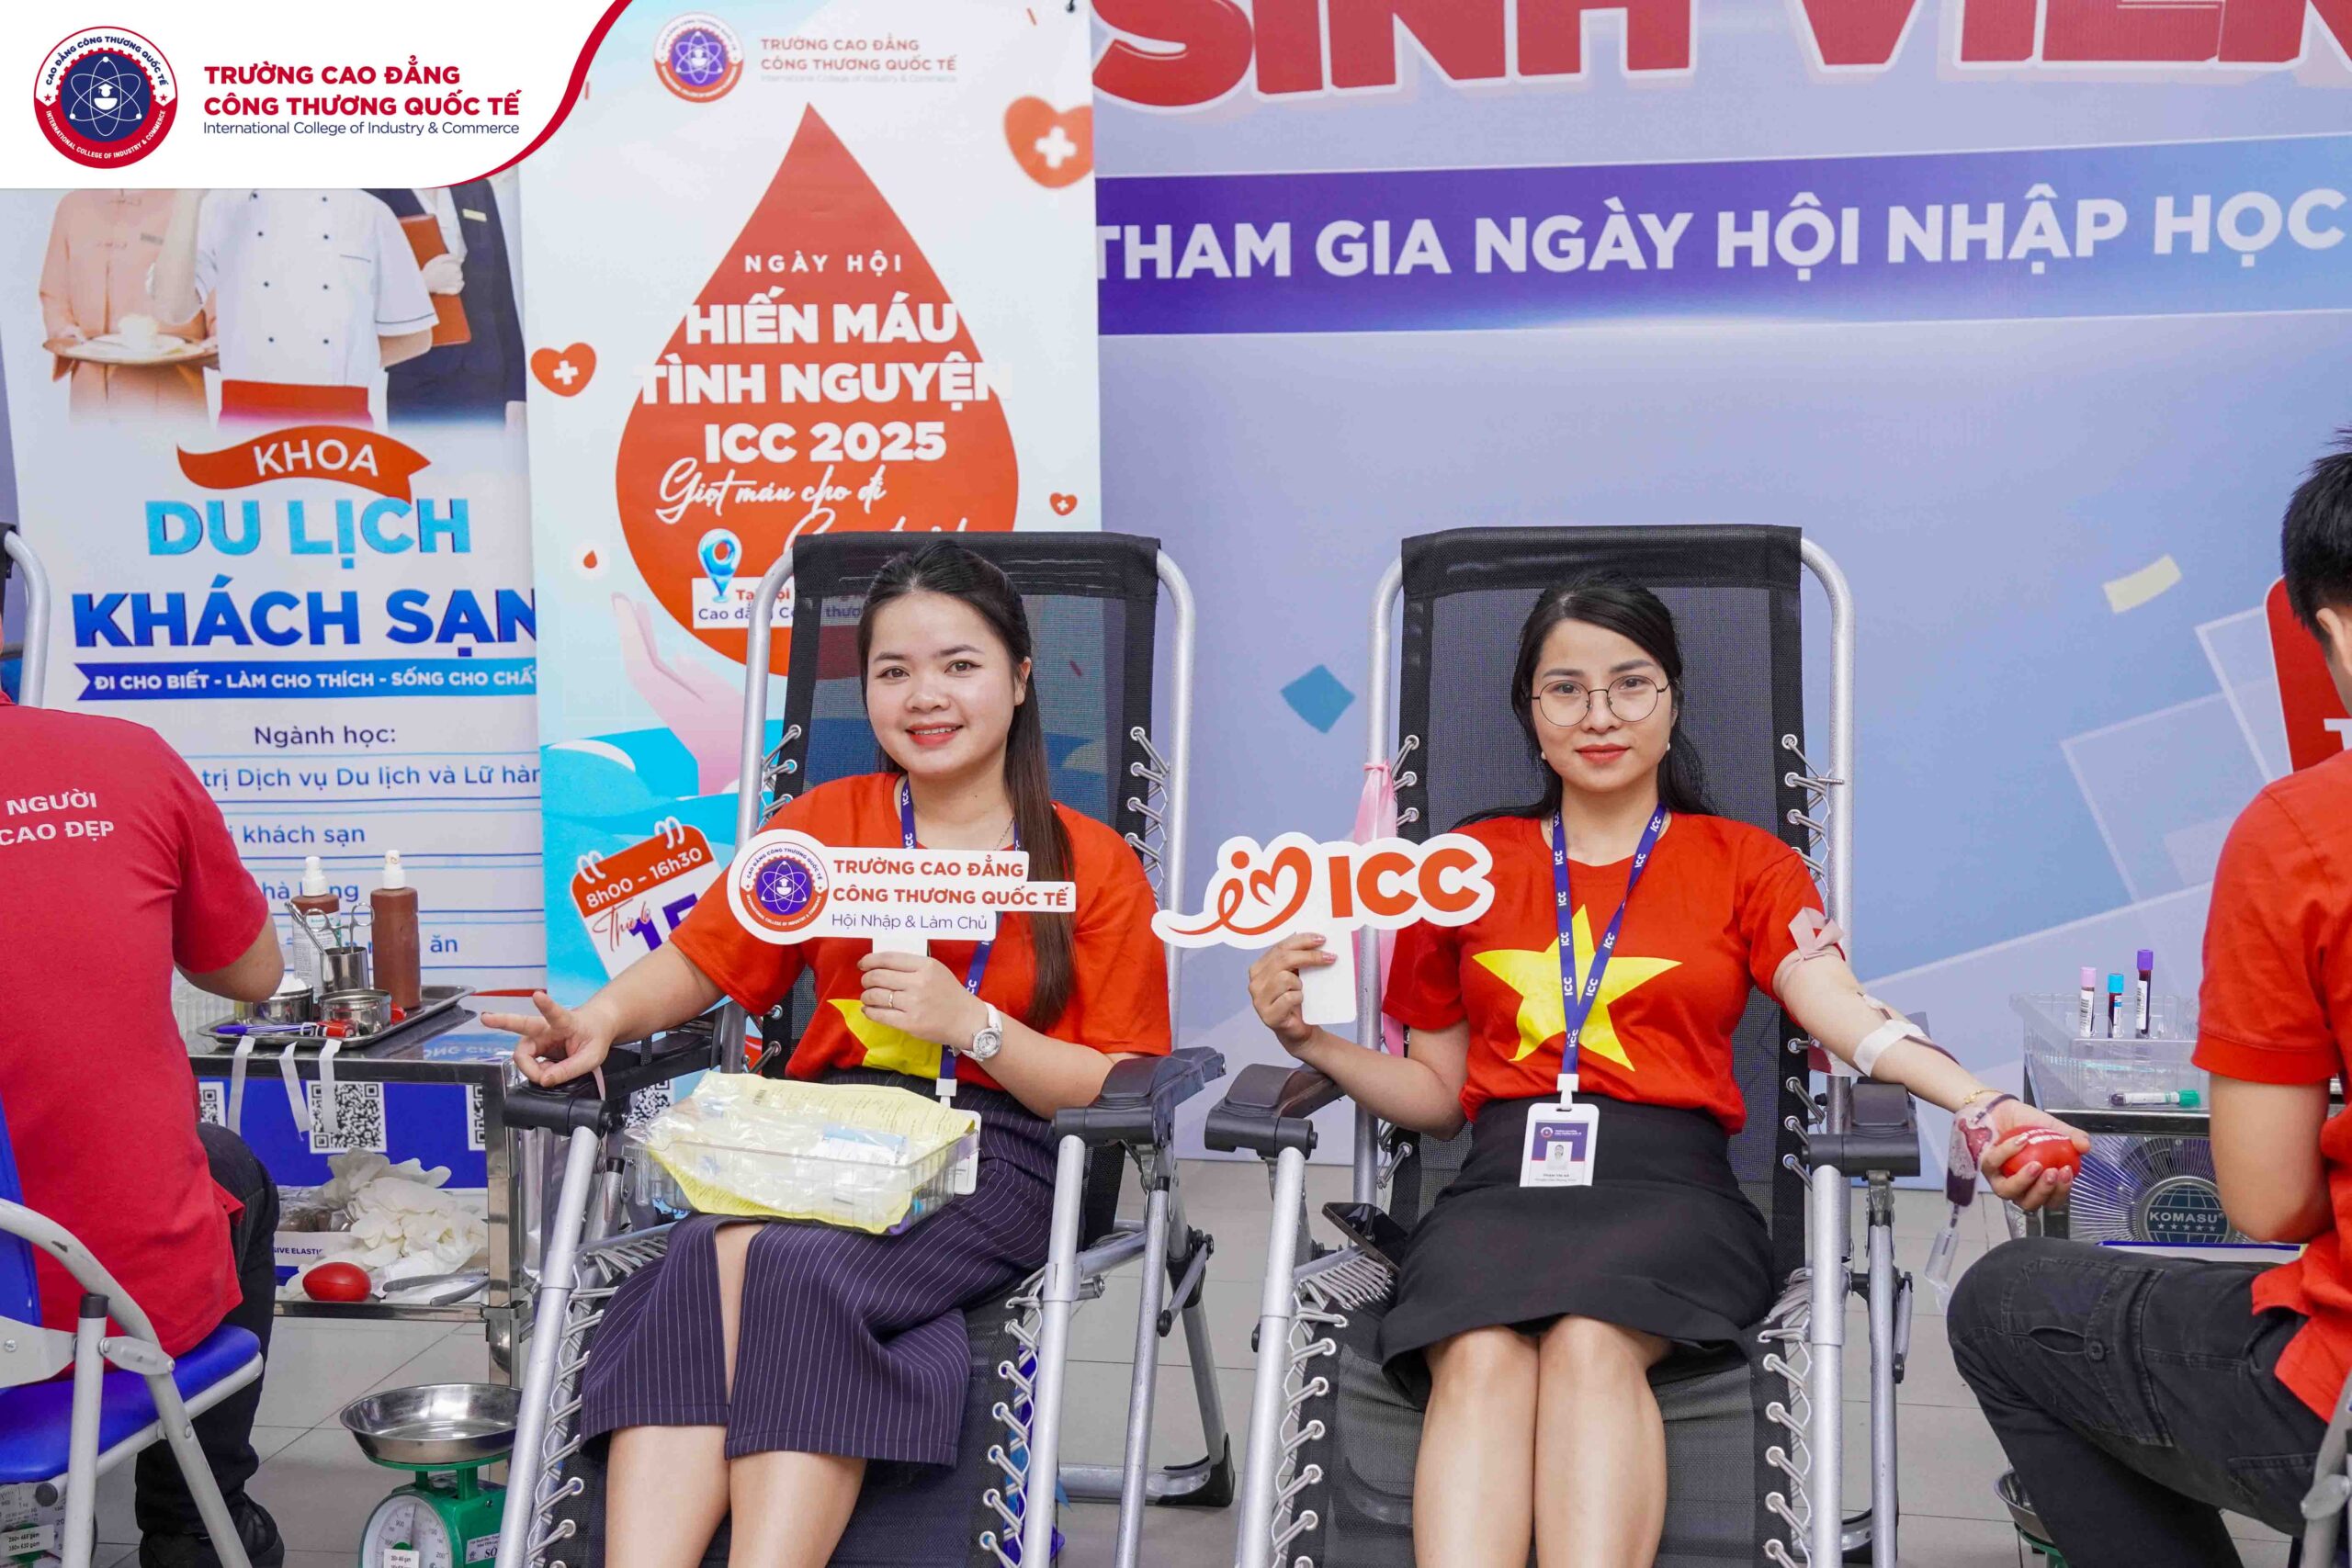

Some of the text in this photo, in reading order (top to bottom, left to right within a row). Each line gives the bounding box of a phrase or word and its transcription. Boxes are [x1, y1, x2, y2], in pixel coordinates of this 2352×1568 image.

[833, 39, 867, 51] CAO
[1096, 184, 2346, 281] THAM GIA NGÀY HỘI NHẬP HỌC
[745, 250, 902, 277] NGÀY HỘI
[684, 286, 958, 344] HIẾN MÁU
[631, 352, 1012, 412] TÌNH NGUYỆN
[705, 421, 947, 464] ICC 2025
[254, 439, 379, 477] KHOA
[735, 479, 796, 502] máu
[801, 465, 852, 513] cho
[144, 497, 471, 570] DU LỊCH
[736, 589, 755, 603] Ta
[71, 574, 537, 657] KHÁCH SẠN
[698, 608, 729, 621] Cao
[96, 675, 115, 691] ĐI
[120, 675, 163, 690] CHO
[167, 669, 209, 690] BIẾT
[227, 671, 267, 689] LÀM
[272, 673, 312, 689] CHO
[317, 670, 375, 688] THÍCH
[391, 667, 444, 687] SỐNG
[449, 671, 488, 686] CHO
[254, 726, 395, 748] Ngành học:
[202, 770, 229, 791] trị
[238, 768, 290, 791] Dịch
[300, 772, 327, 791] vụ
[337, 768, 368, 786] Du
[379, 765, 419, 789] lịch
[429, 768, 456, 784] và
[465, 765, 493, 784] Lữ
[6, 788, 97, 816] NGƯỜI
[0, 820, 114, 845] CAO ĐẸP
[1650, 816, 1661, 832] ICC
[243, 825, 314, 843] khách
[324, 827, 366, 846] sạn
[833, 854, 1023, 877] TRƯỜNG CAO ĐẲNG
[1555, 850, 1564, 865] ICC
[1634, 852, 1646, 868] ICC
[585, 877, 633, 908] 8h00
[650, 848, 703, 880] 16h30
[1329, 848, 1480, 918] ICC
[263, 882, 290, 900] hà
[832, 884, 1069, 907] CÔNG THƯƠNG QUỐC TẾ
[1558, 891, 1566, 907] ICC
[831, 913, 988, 931] Hội Nhập & Làm Chủ
[430, 935, 458, 953] ăn
[1561, 931, 1569, 946] ICC
[1603, 932, 1615, 949] ICC
[1565, 976, 1573, 996] ICC
[1586, 978, 1599, 997] ICC
[1569, 1029, 1578, 1047] ICC
[2150, 1212, 2218, 1224] KOMASU
